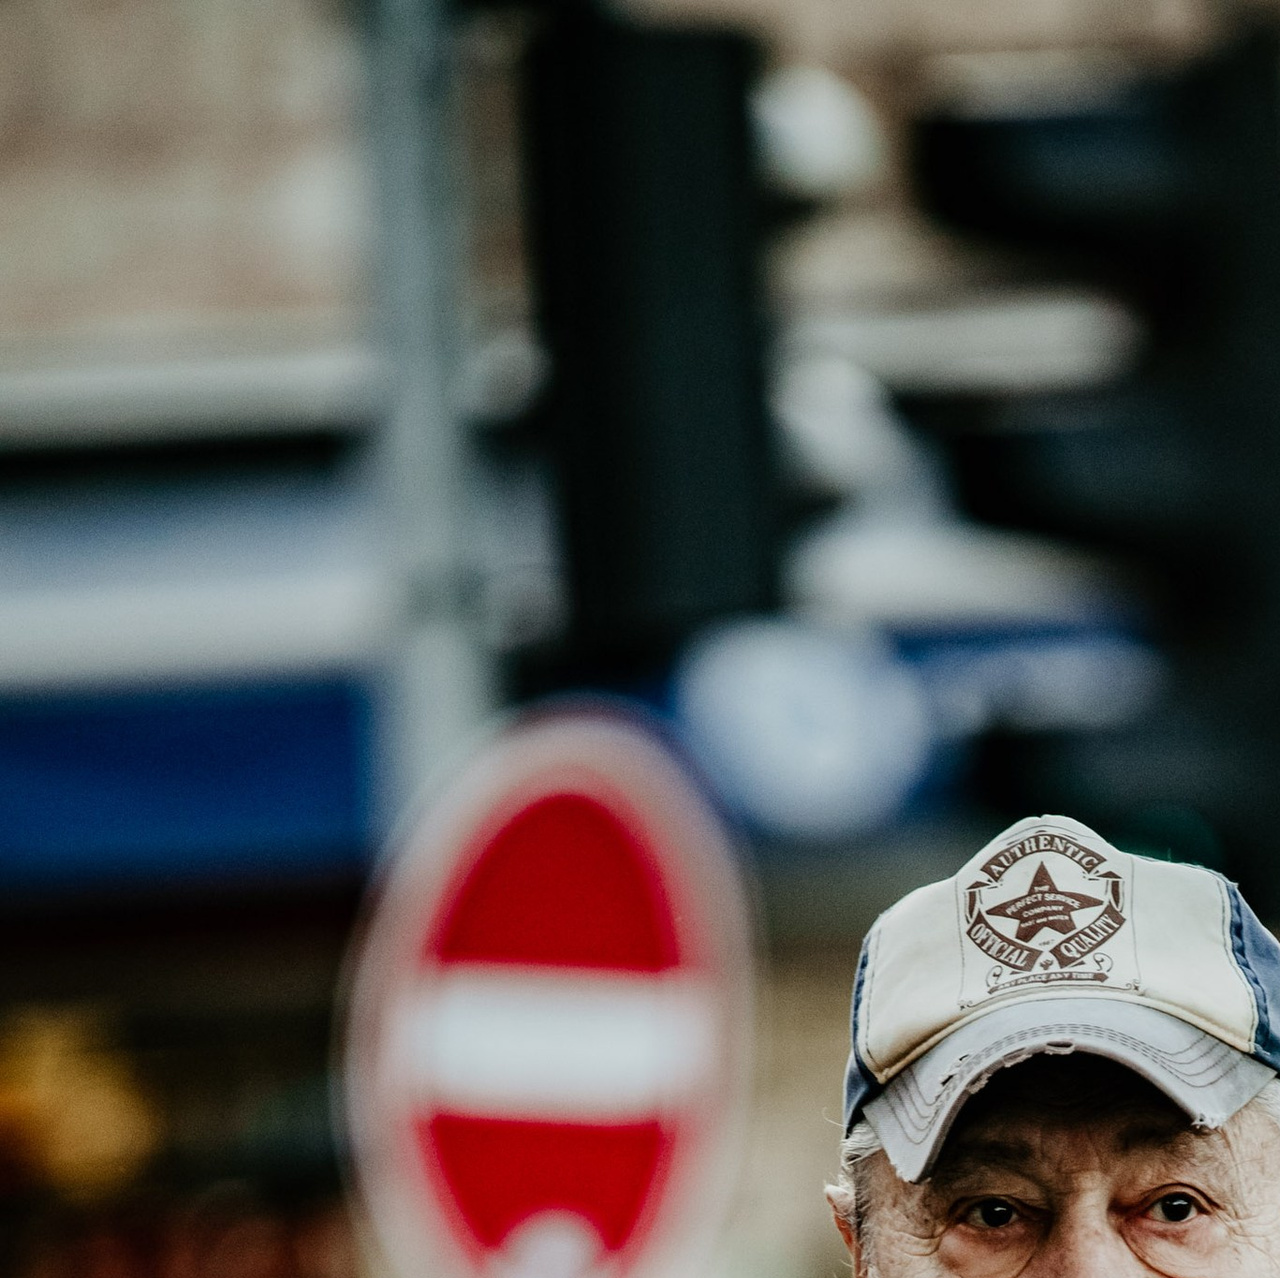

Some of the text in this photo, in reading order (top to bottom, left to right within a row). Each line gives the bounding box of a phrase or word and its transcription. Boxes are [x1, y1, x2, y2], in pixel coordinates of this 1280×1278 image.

[990, 834, 1099, 877] AUTHENTIC
[1005, 893, 1043, 915] PERFECT
[1022, 905, 1064, 917] COMPANY
[970, 923, 1031, 967] OFFICIAL
[1060, 914, 1120, 958] QUALITY
[1016, 974, 1047, 985] PLACE
[1049, 972, 1070, 980] ANY
